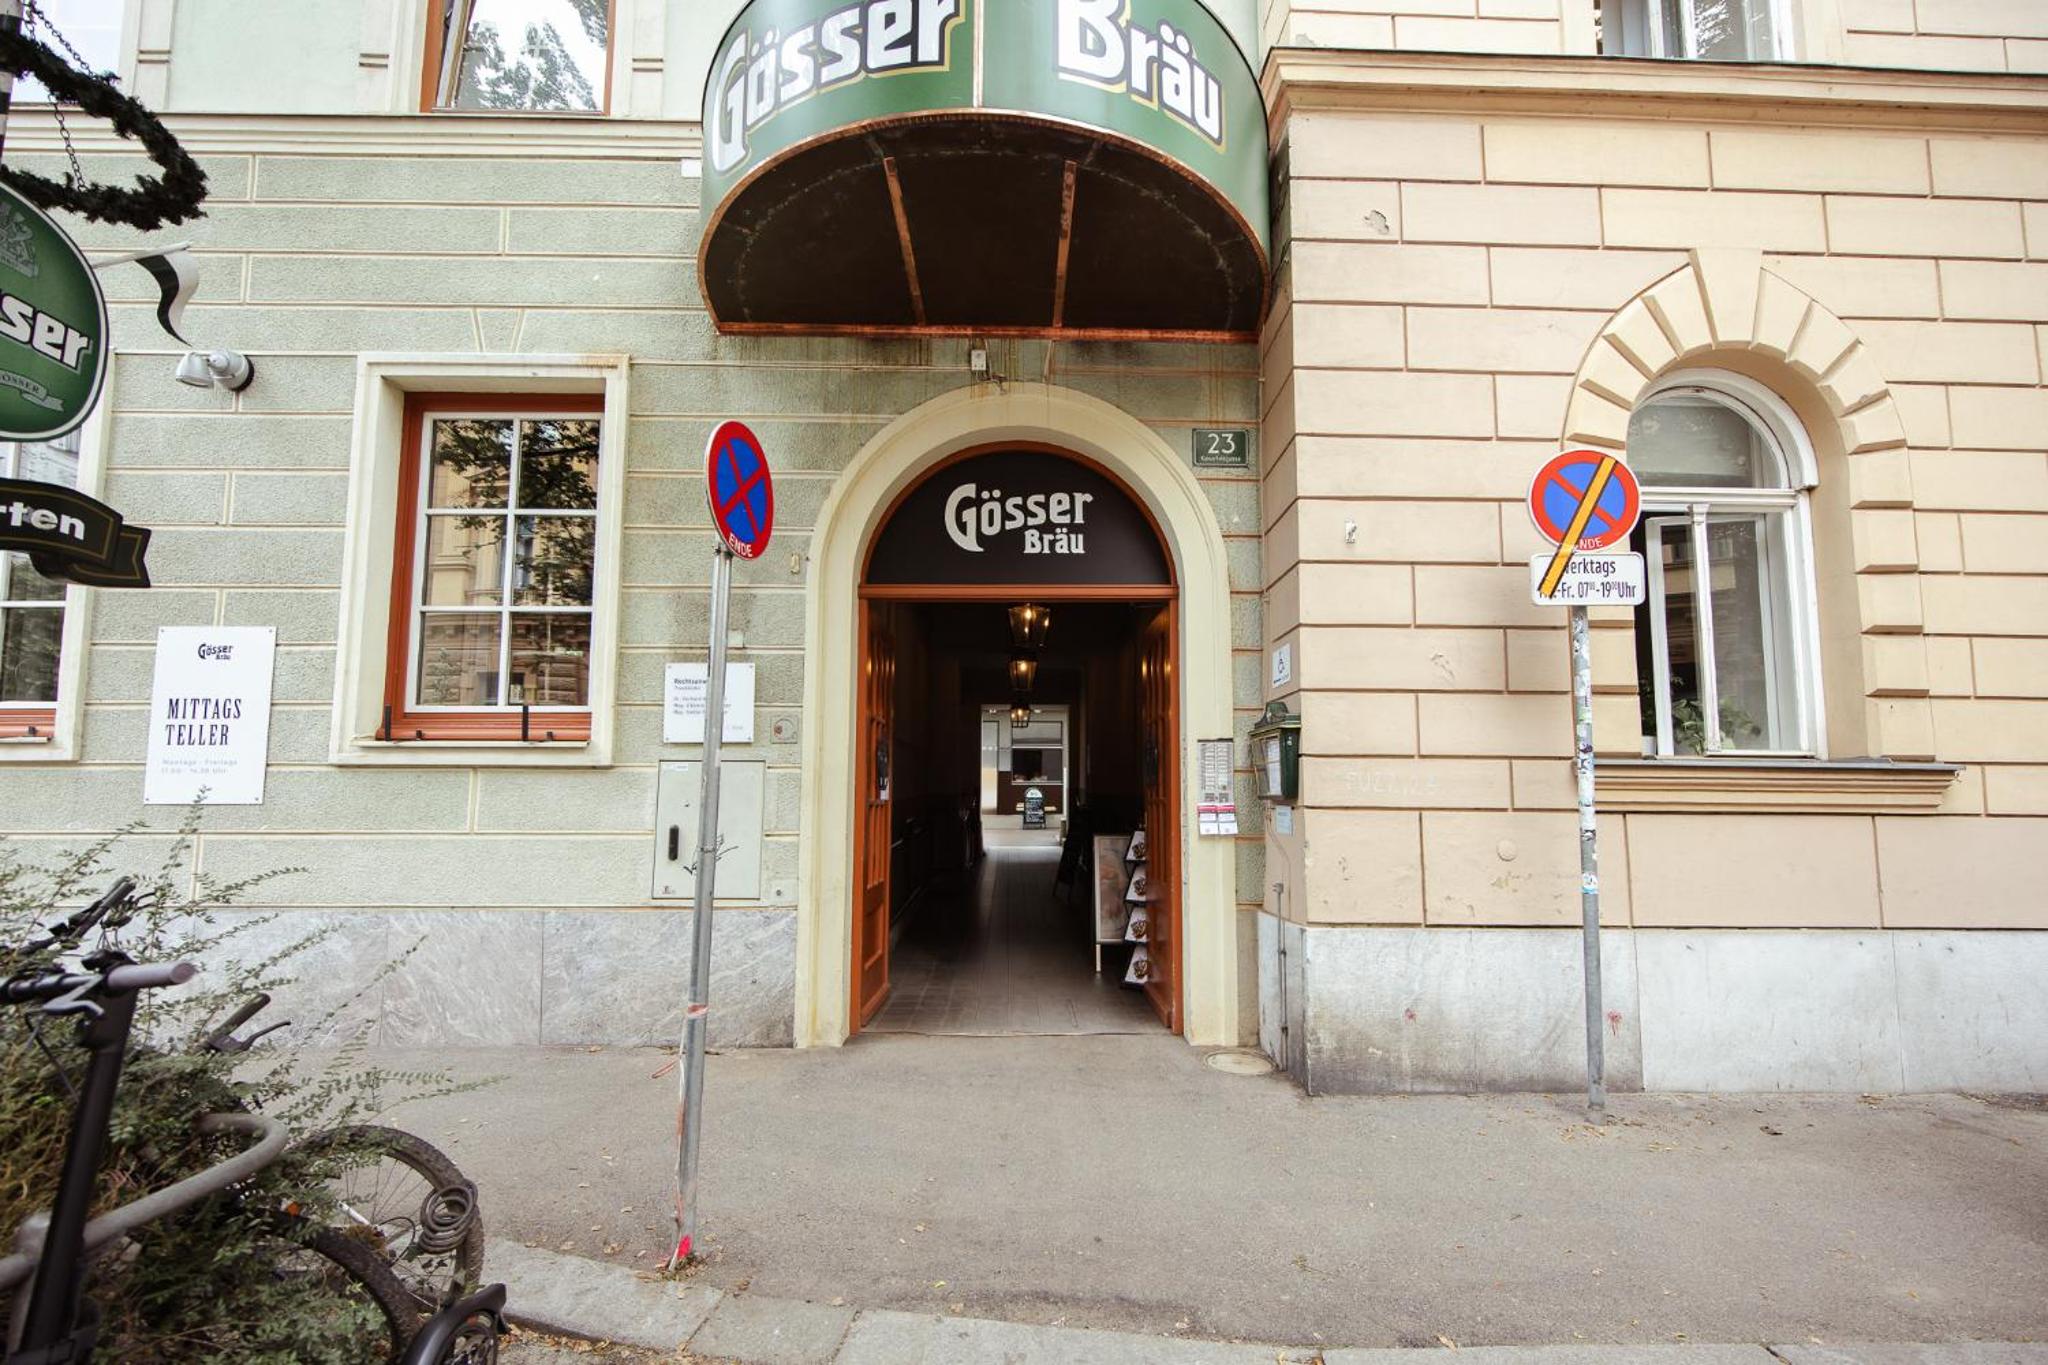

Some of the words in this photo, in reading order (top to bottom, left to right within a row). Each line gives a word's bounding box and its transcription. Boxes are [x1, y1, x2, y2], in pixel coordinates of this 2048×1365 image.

[711, 0, 957, 172] Gösser
[1056, 0, 1221, 141] Bräu
[1207, 433, 1235, 454] 23
[944, 483, 1093, 553] Gösser
[728, 532, 753, 557] ENDE
[1023, 528, 1085, 554] Bräu
[1574, 537, 1603, 550] NDE
[198, 643, 233, 660] Gösser
[167, 698, 241, 719] MITTAGS
[165, 724, 229, 745] TELLER
